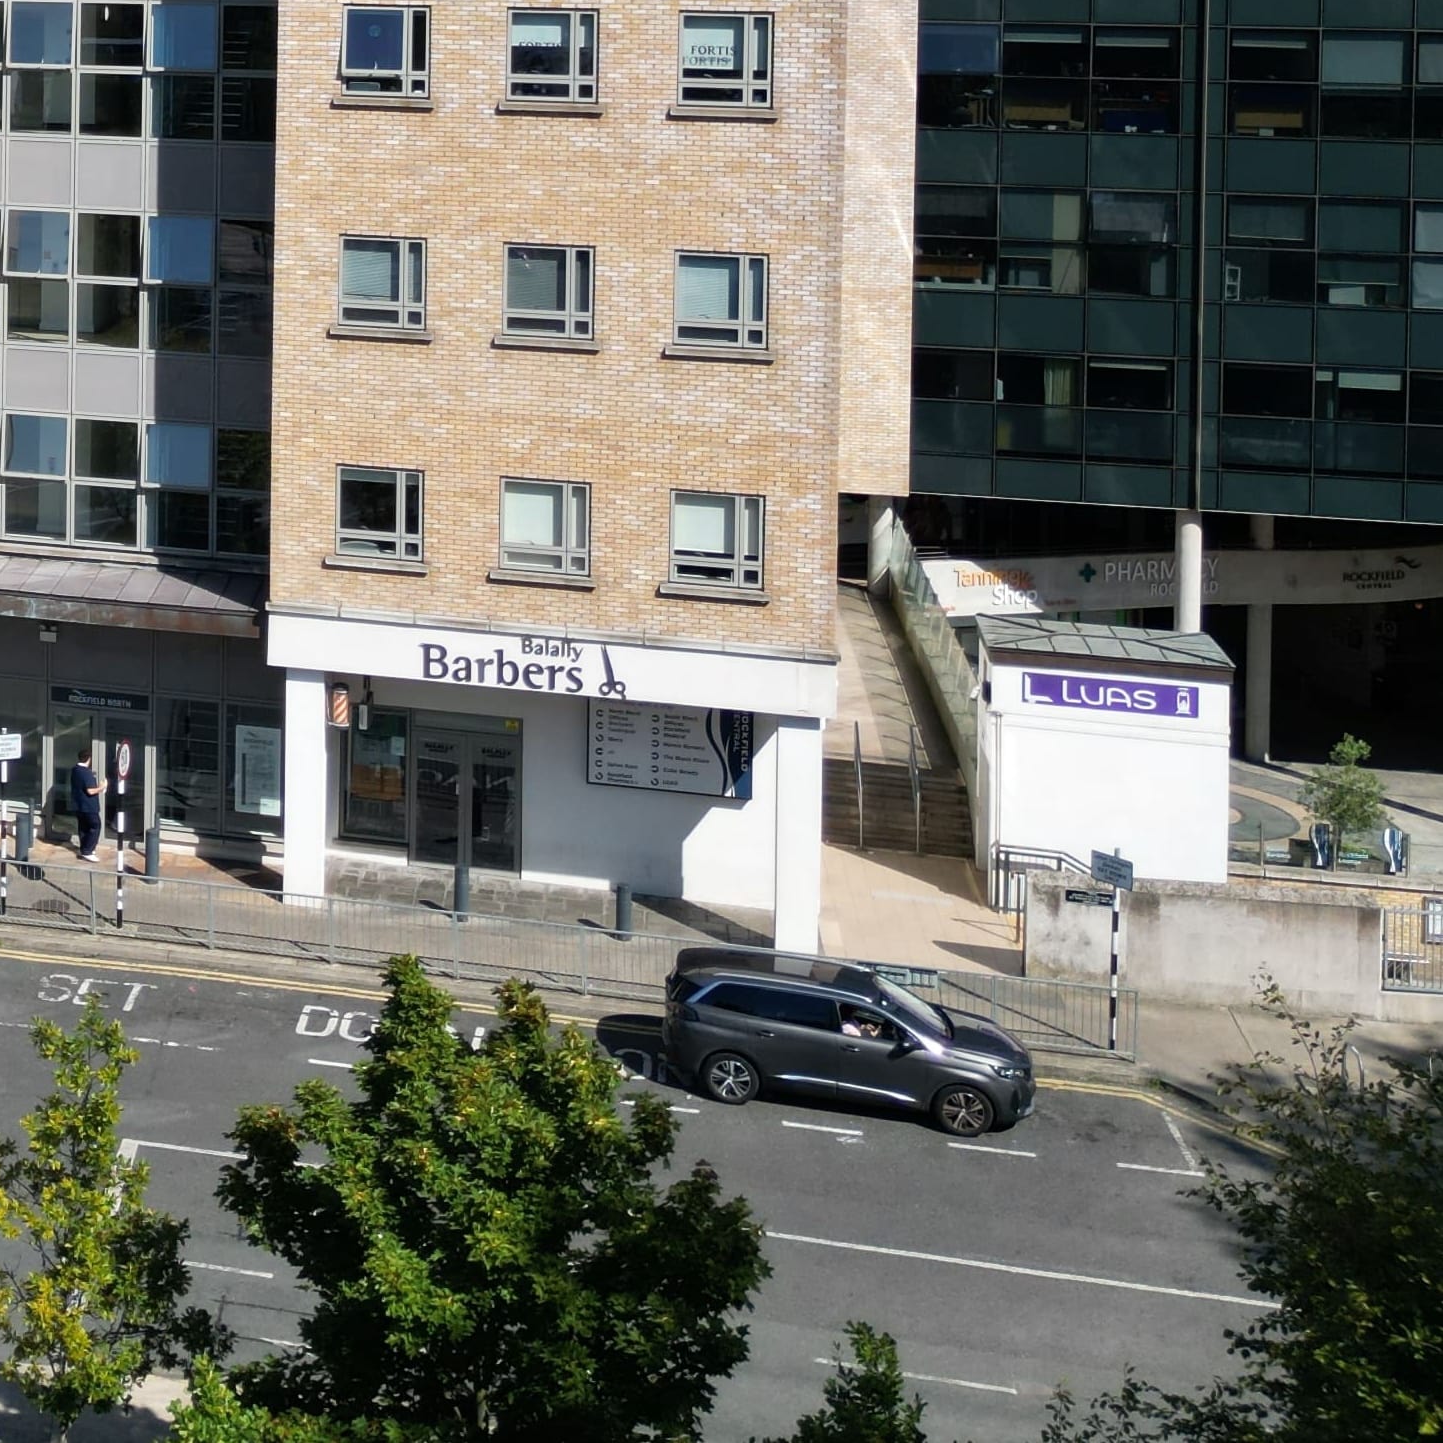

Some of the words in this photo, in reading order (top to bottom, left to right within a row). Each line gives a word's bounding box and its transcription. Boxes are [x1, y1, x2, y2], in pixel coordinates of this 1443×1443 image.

[691, 45, 737, 56] FORTIS
[1104, 558, 1219, 581] PHARMY
[1343, 569, 1405, 582] ROCKFIELD
[992, 584, 1038, 608] Shop
[1150, 581, 1219, 596] ROCLD
[521, 636, 583, 663] Balally
[418, 643, 583, 693] Barbers
[1062, 680, 1157, 710] LUAS
[733, 713, 741, 752] ENTRAL
[38, 974, 158, 1011] SET
